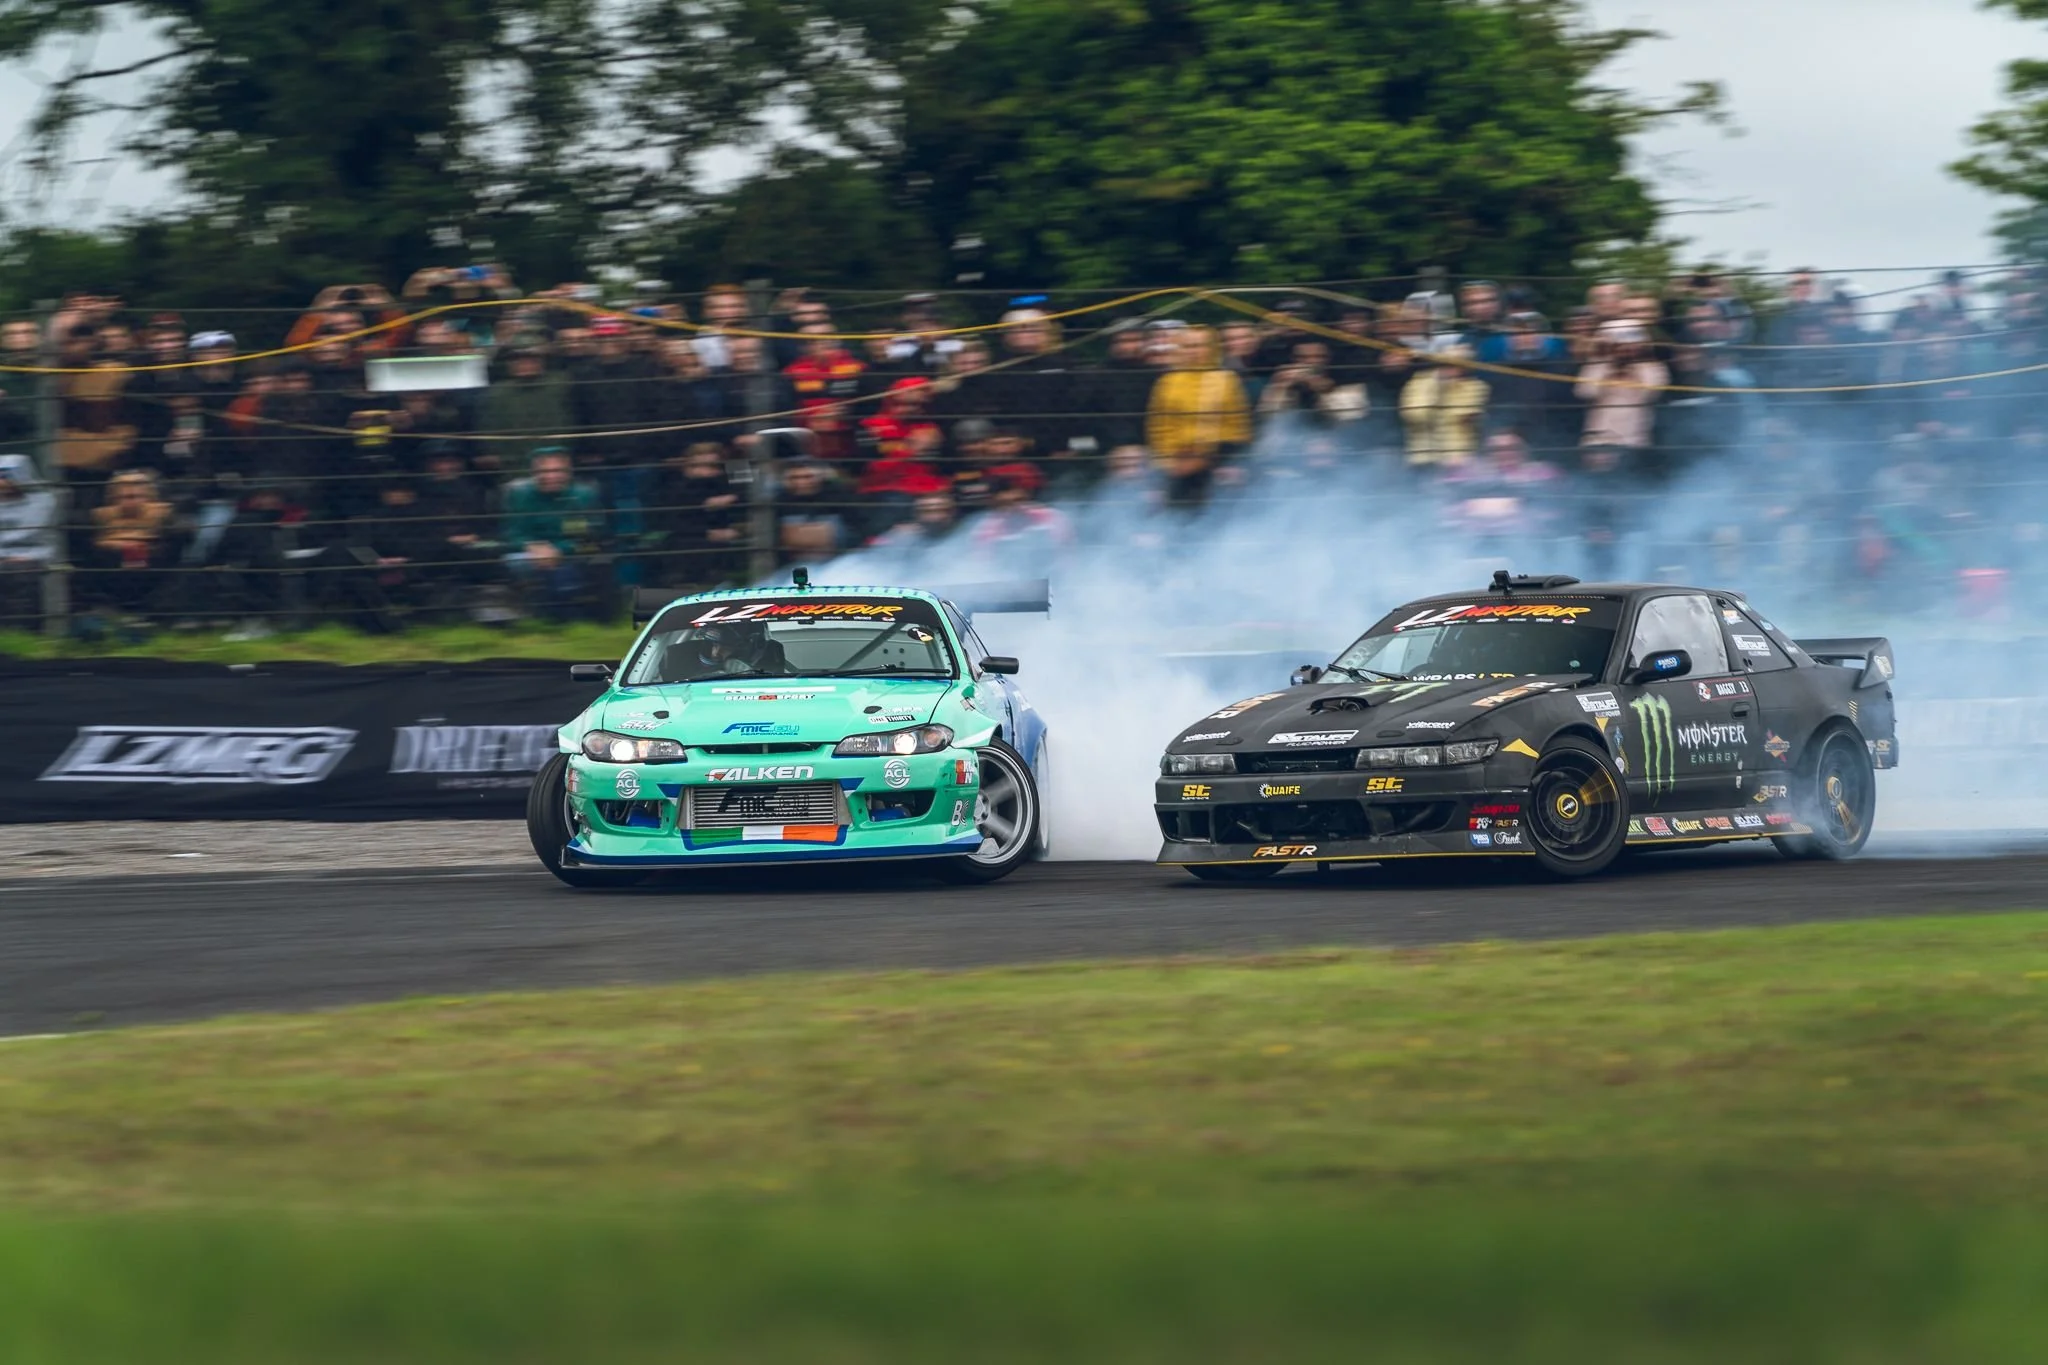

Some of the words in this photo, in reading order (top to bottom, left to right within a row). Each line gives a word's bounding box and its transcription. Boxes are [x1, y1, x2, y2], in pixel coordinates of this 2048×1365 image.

[690, 603, 775, 624] LZ
[756, 604, 903, 617] WORLDTOUR
[1394, 604, 1476, 629] LZ
[1691, 751, 1739, 764] ENERGY
[705, 765, 814, 782] FALKEN
[884, 768, 911, 779] ACL
[615, 779, 641, 789] ACL
[1265, 785, 1301, 797] QUAIFE
